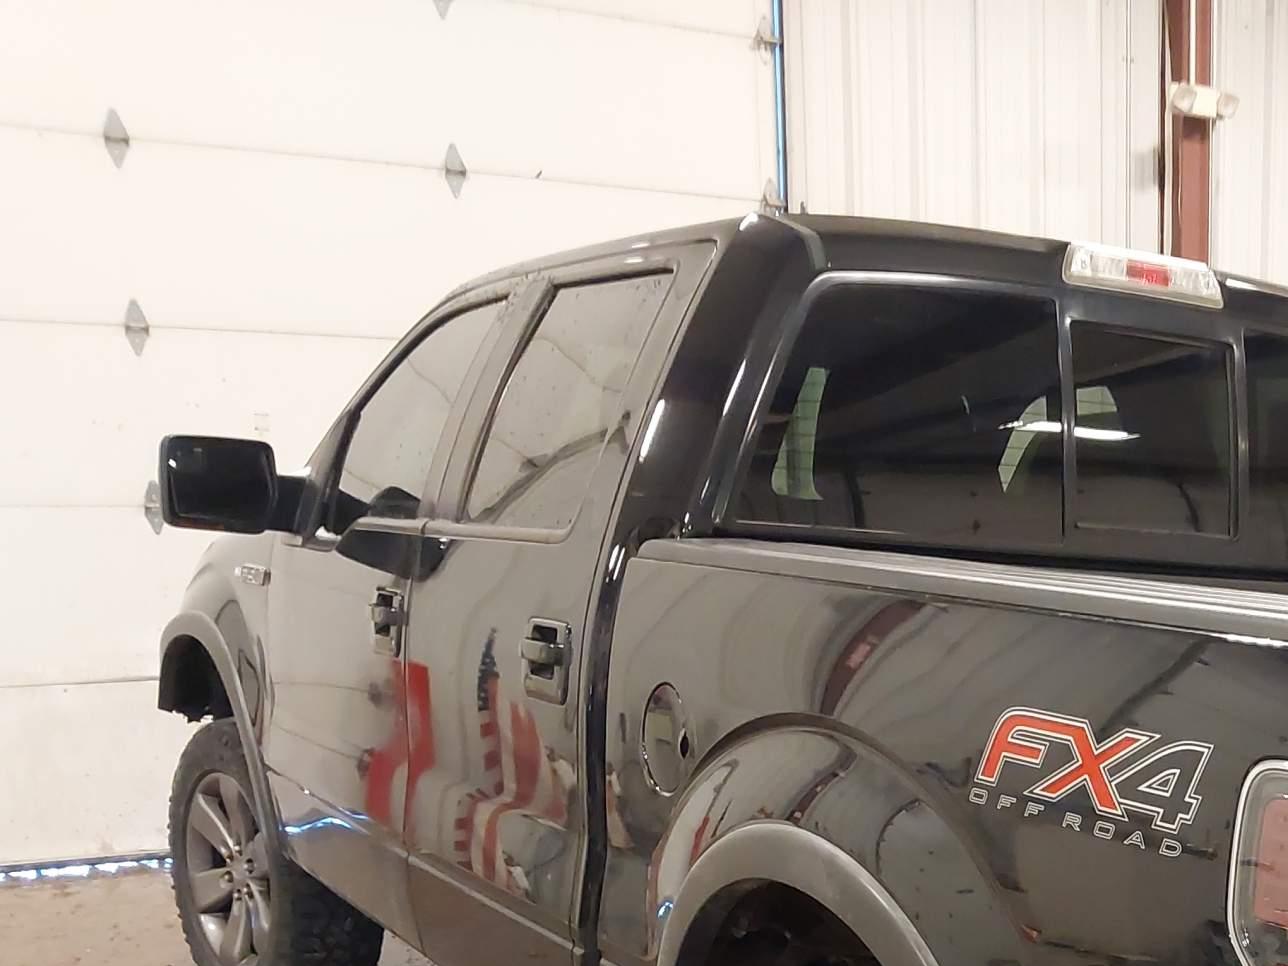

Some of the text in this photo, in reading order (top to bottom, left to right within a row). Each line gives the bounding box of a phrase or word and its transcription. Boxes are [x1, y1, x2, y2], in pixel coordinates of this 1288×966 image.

[974, 706, 1214, 834] FX4
[968, 787, 1183, 857] OFF ROAD
